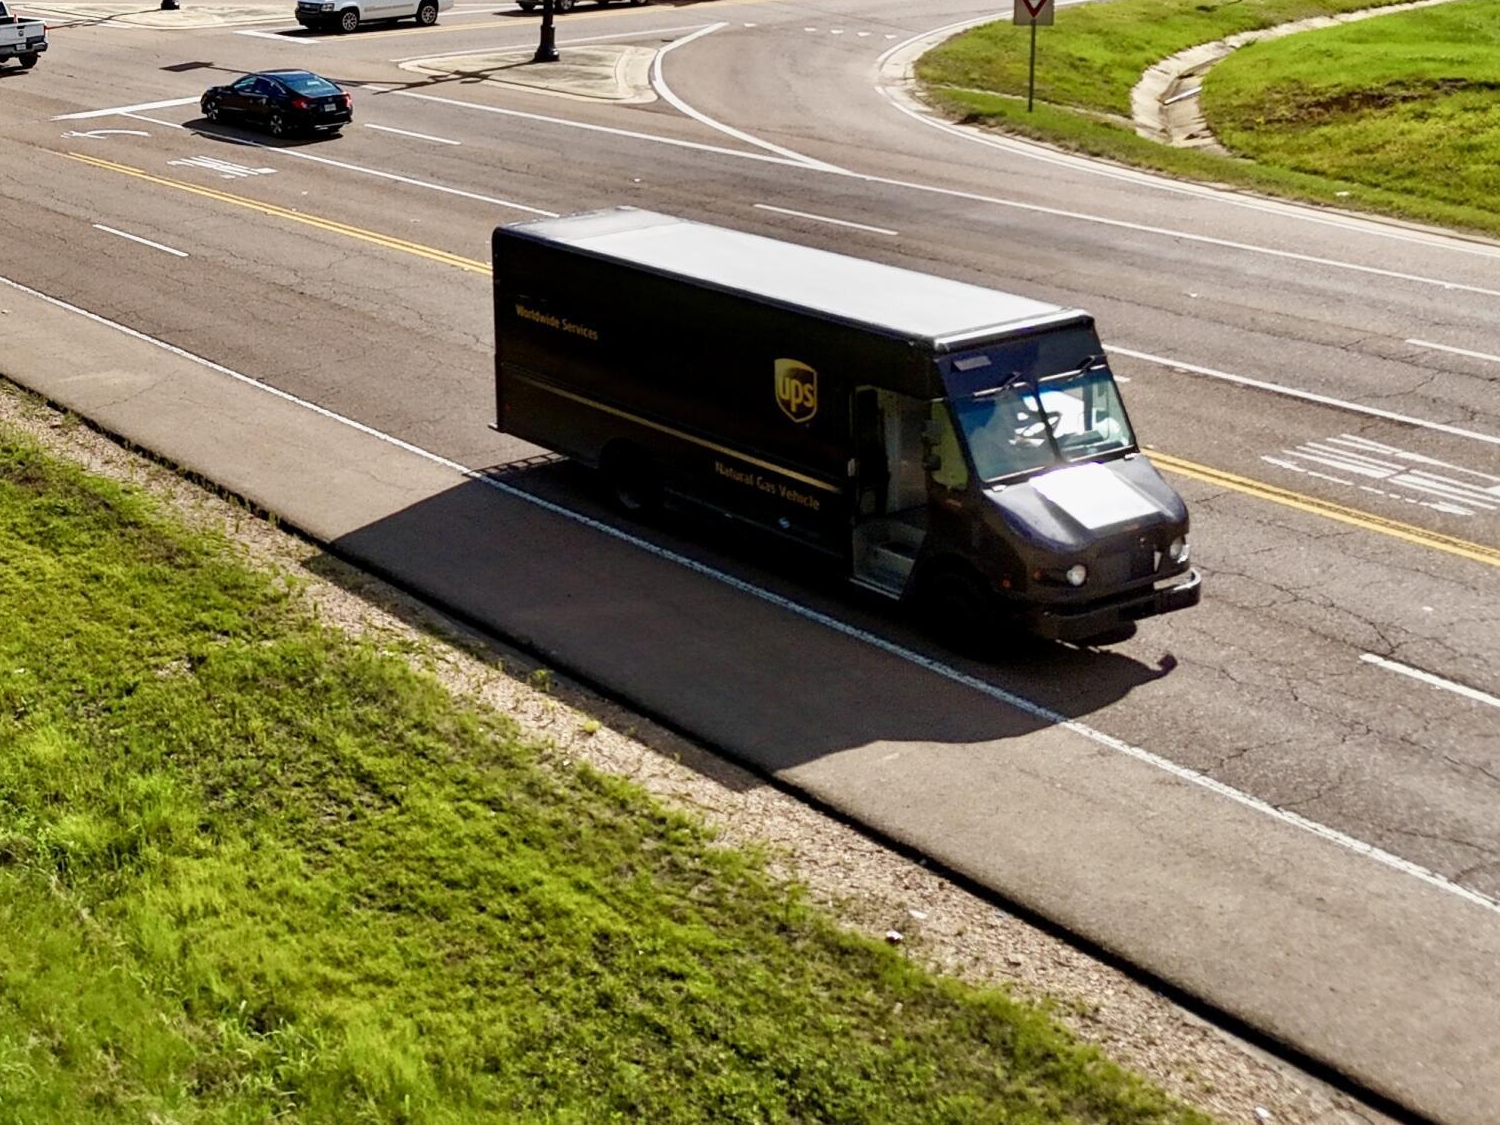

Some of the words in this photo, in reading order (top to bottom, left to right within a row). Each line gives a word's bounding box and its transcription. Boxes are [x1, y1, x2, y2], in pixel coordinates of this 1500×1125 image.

[516, 303, 560, 329] Worldwide
[562, 318, 598, 341] Services
[779, 377, 815, 413] ups
[714, 460, 754, 486] Natural
[756, 476, 777, 494] Gas
[779, 483, 821, 511] Vehicle
